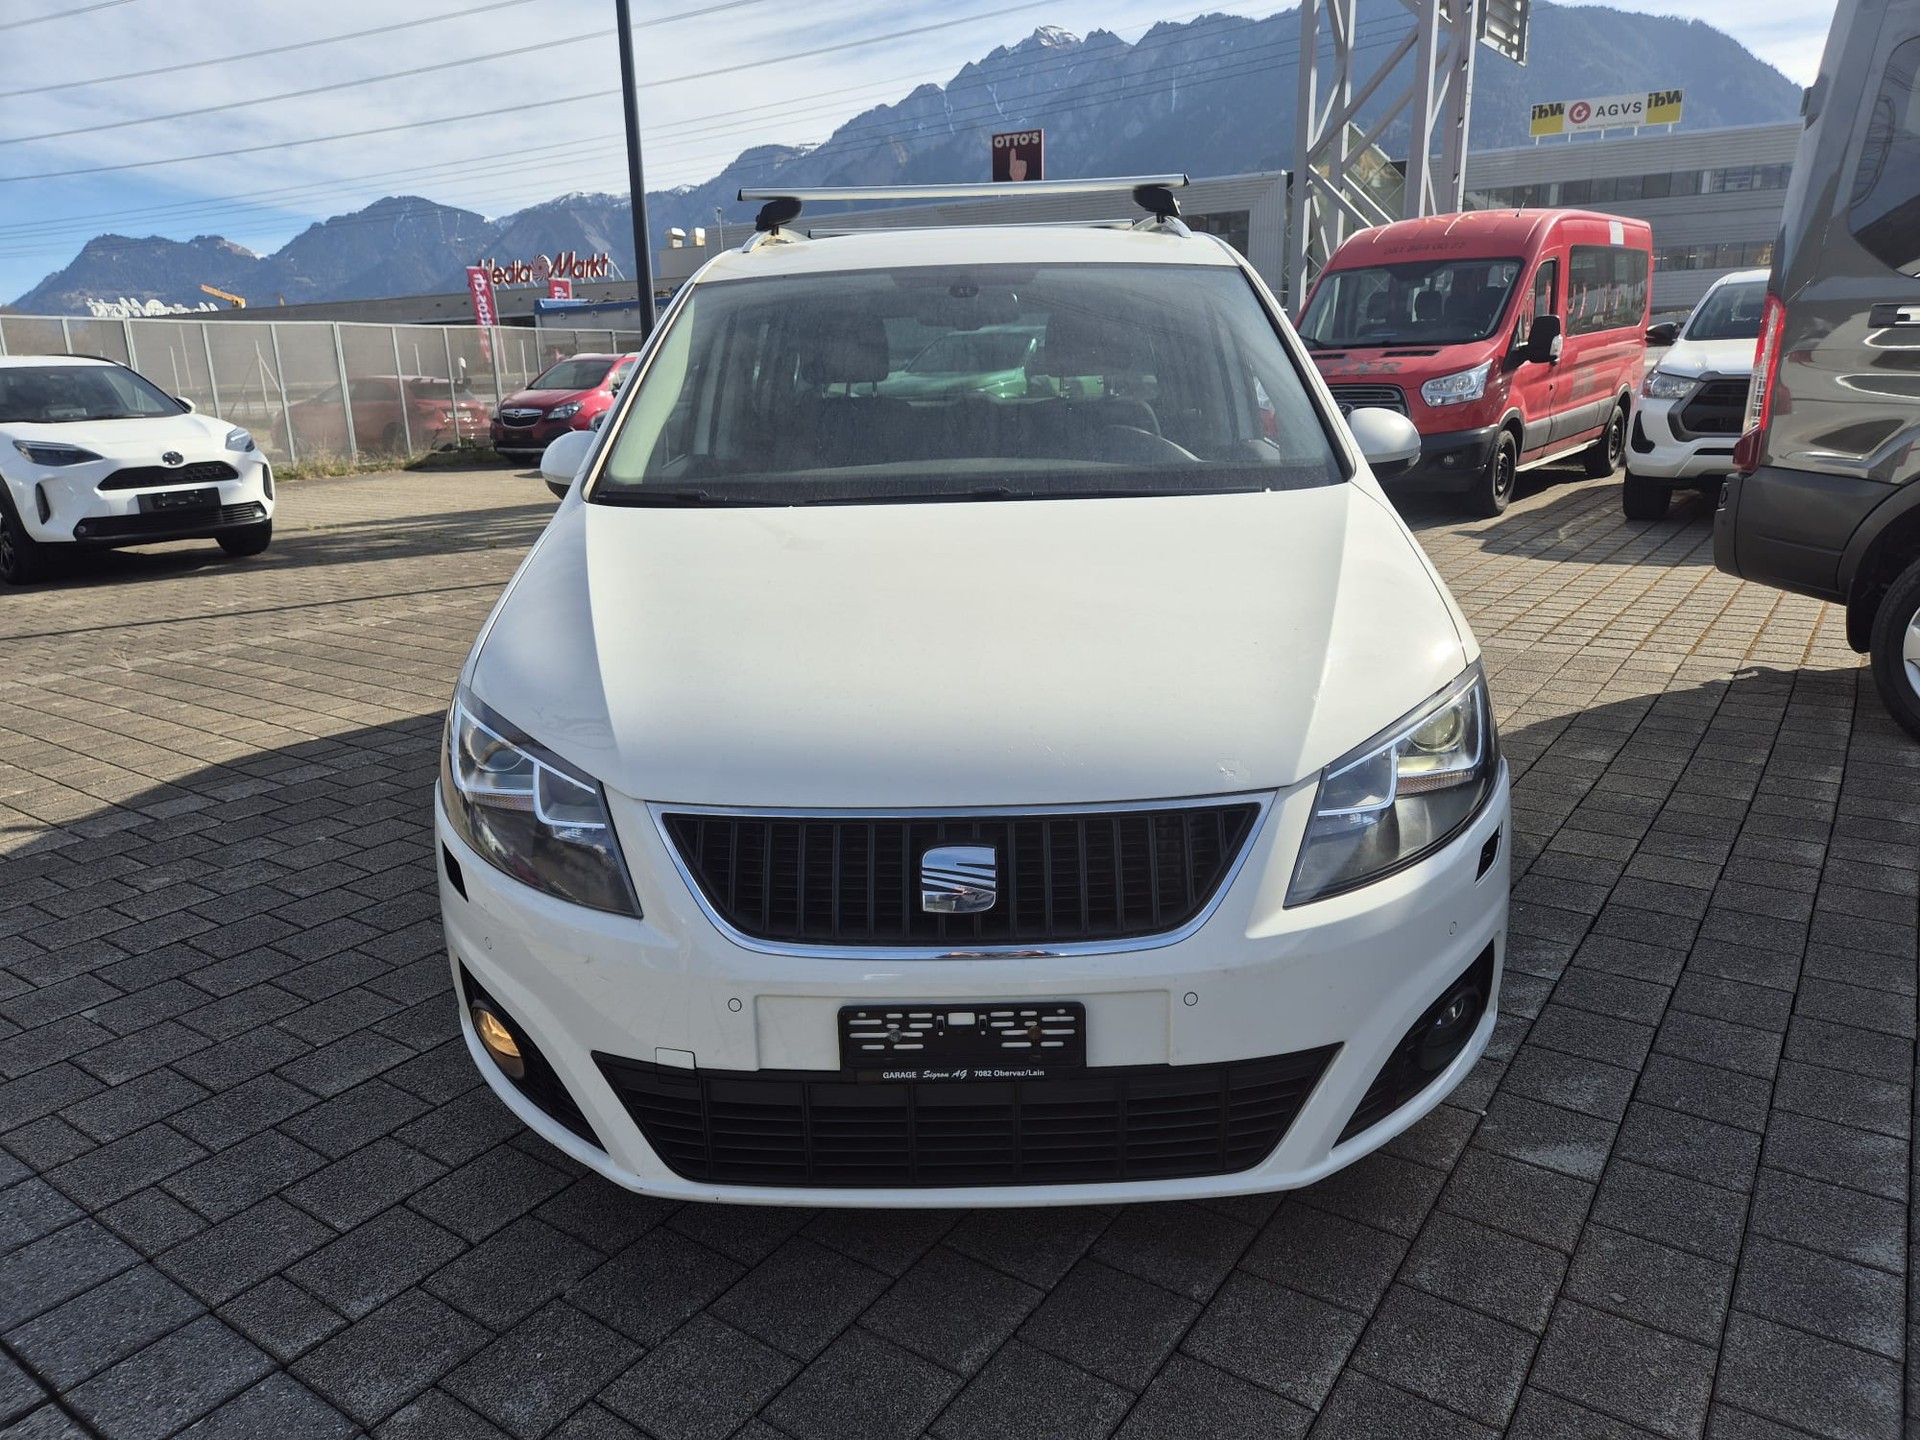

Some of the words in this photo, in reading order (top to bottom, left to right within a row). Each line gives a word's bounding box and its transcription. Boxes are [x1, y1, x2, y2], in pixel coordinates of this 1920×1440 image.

[1596, 102, 1642, 117] AGVS
[994, 132, 1040, 148] OTTO'S
[549, 251, 609, 279] Markt
[882, 1071, 917, 1079] GARAGE
[951, 1069, 968, 1079] AG
[993, 1069, 1045, 1077] Obervaz/Lain
